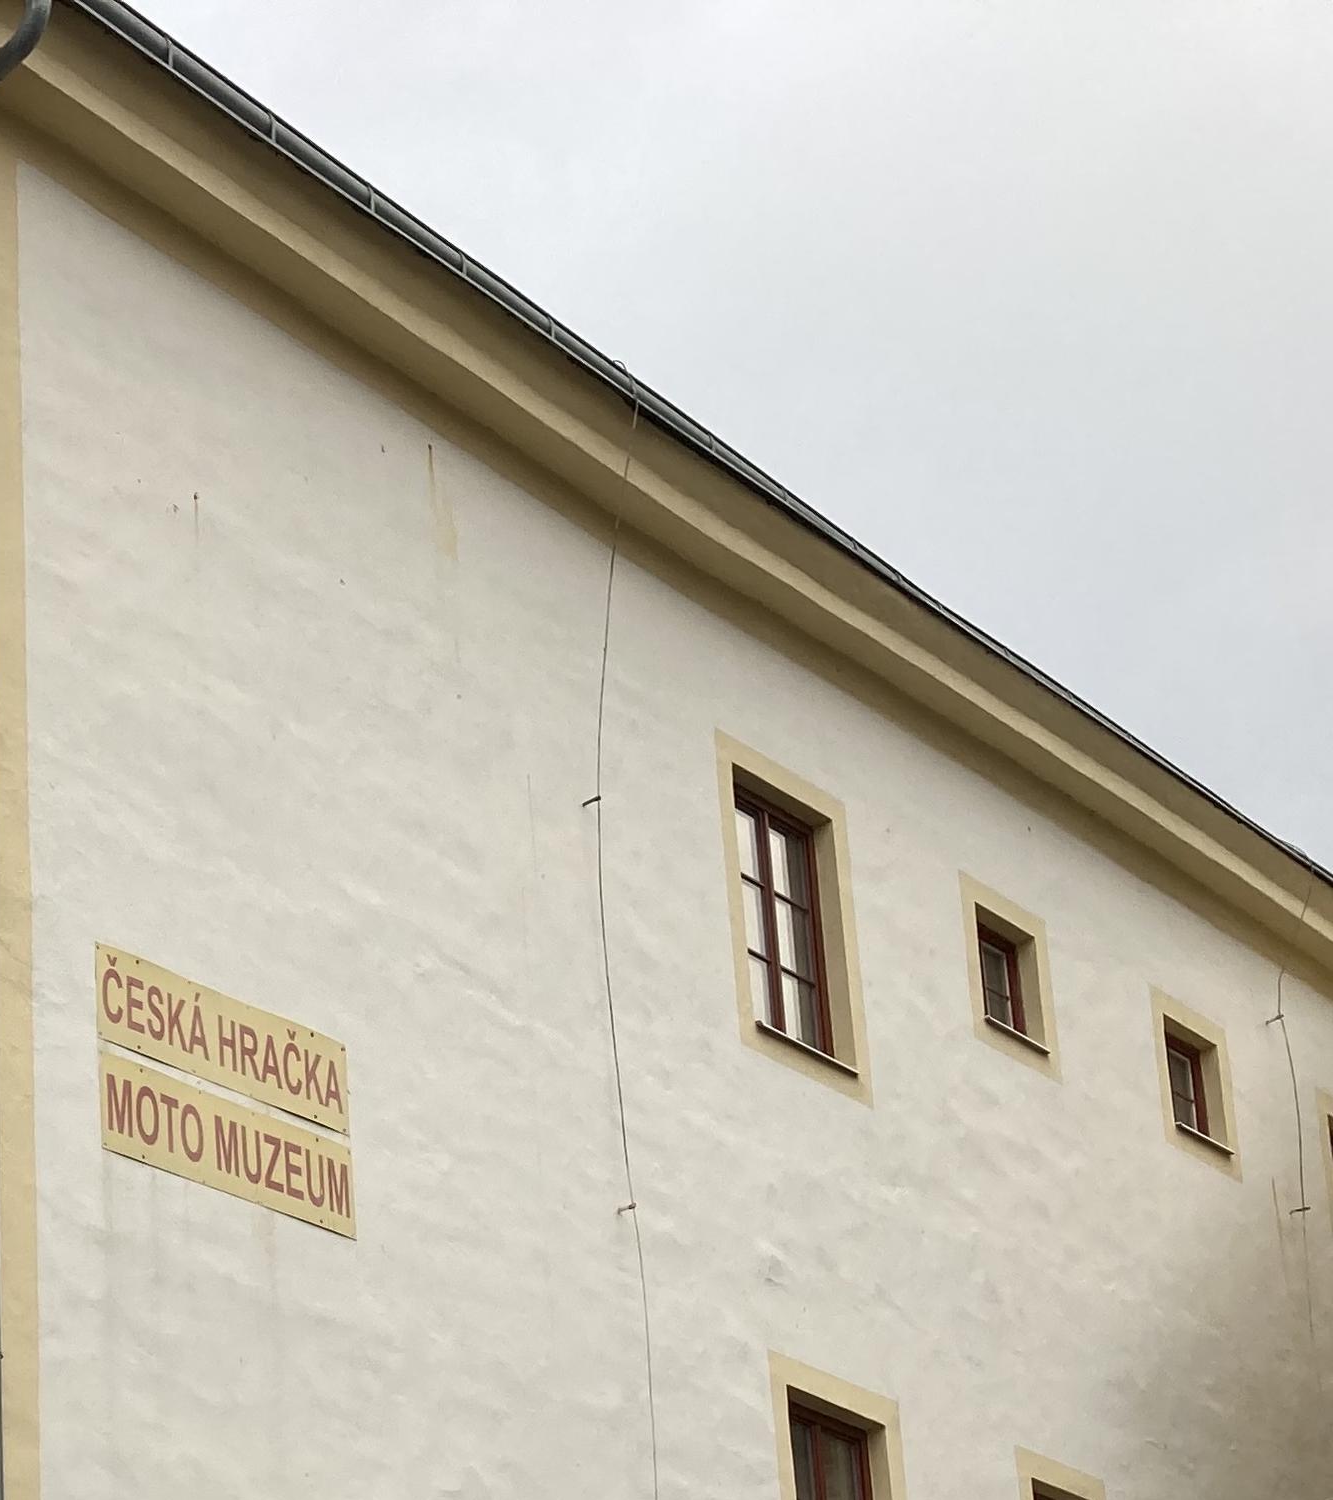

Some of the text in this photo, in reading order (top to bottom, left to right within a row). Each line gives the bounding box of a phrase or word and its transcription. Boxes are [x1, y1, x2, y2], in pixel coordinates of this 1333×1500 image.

[102, 954, 343, 1114] ČESKÁ HRAČKA
[106, 1073, 351, 1218] MOTO MUZEUM
